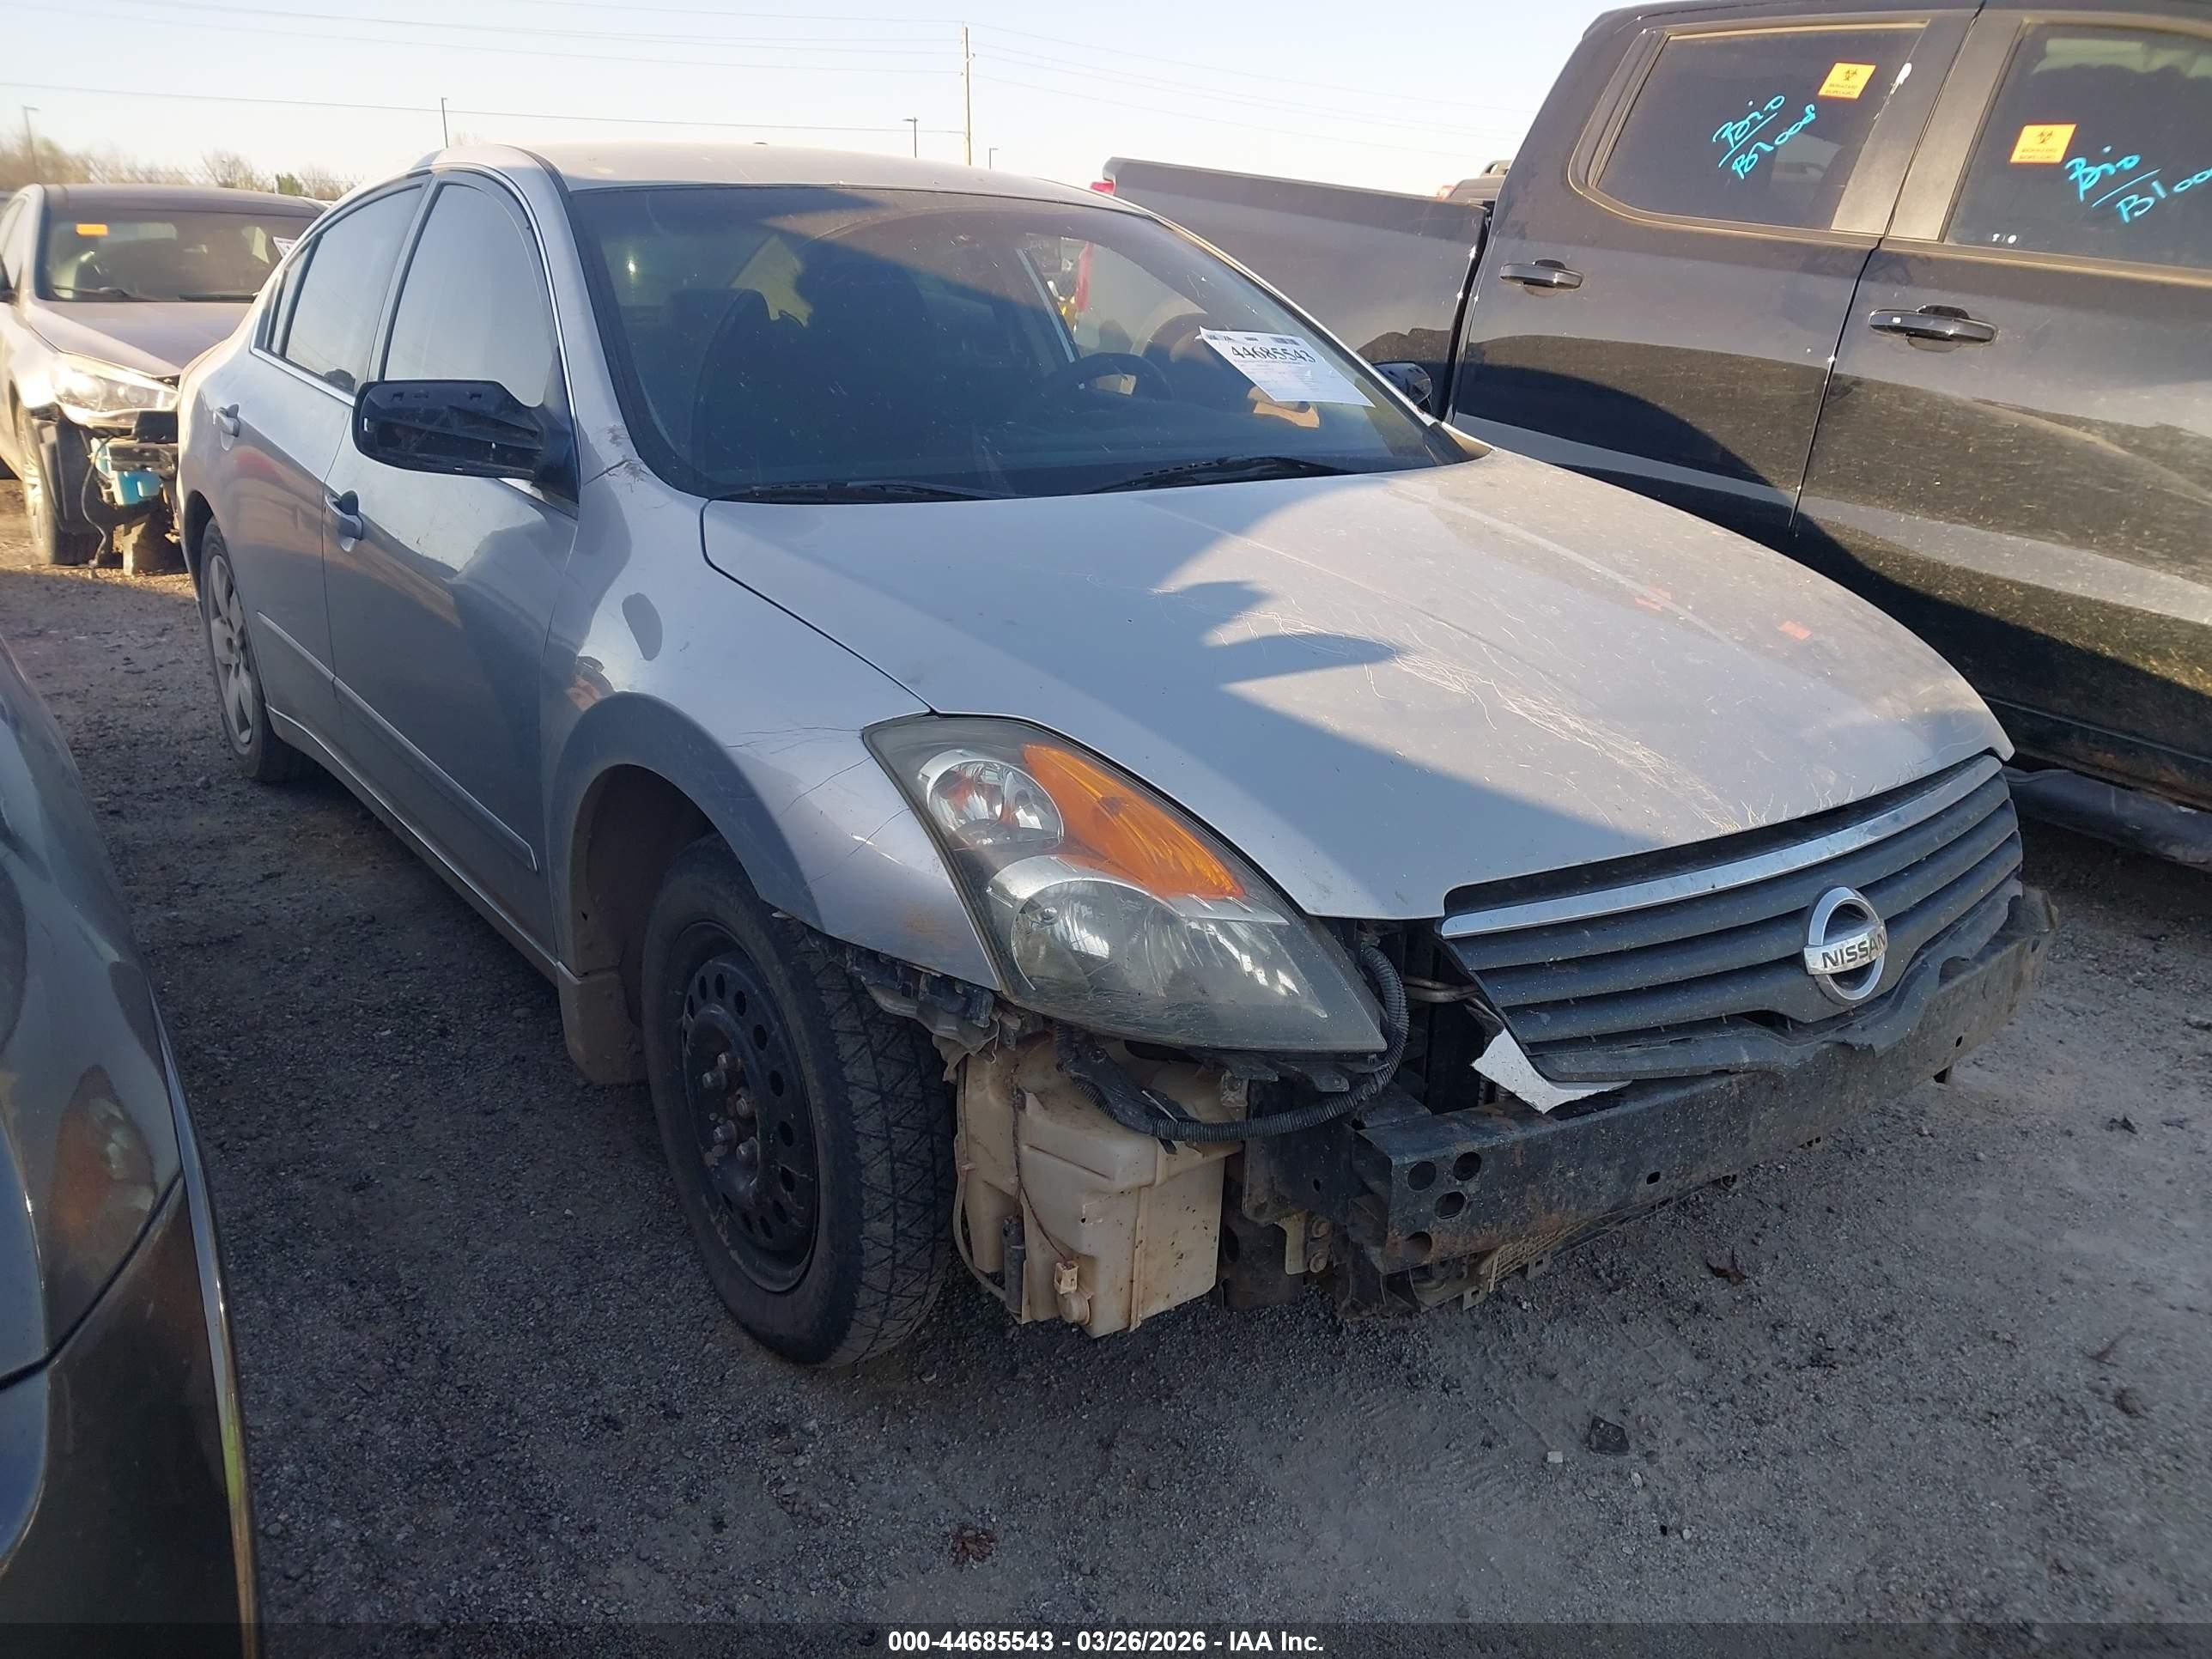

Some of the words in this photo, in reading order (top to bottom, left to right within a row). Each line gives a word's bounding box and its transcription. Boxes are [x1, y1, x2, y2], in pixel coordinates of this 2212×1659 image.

[2064, 145, 2142, 203] Bio
[2116, 167, 2212, 223] Bloo
[1231, 345, 1316, 363] 44685543
[1821, 930, 1887, 969] NISSAN
